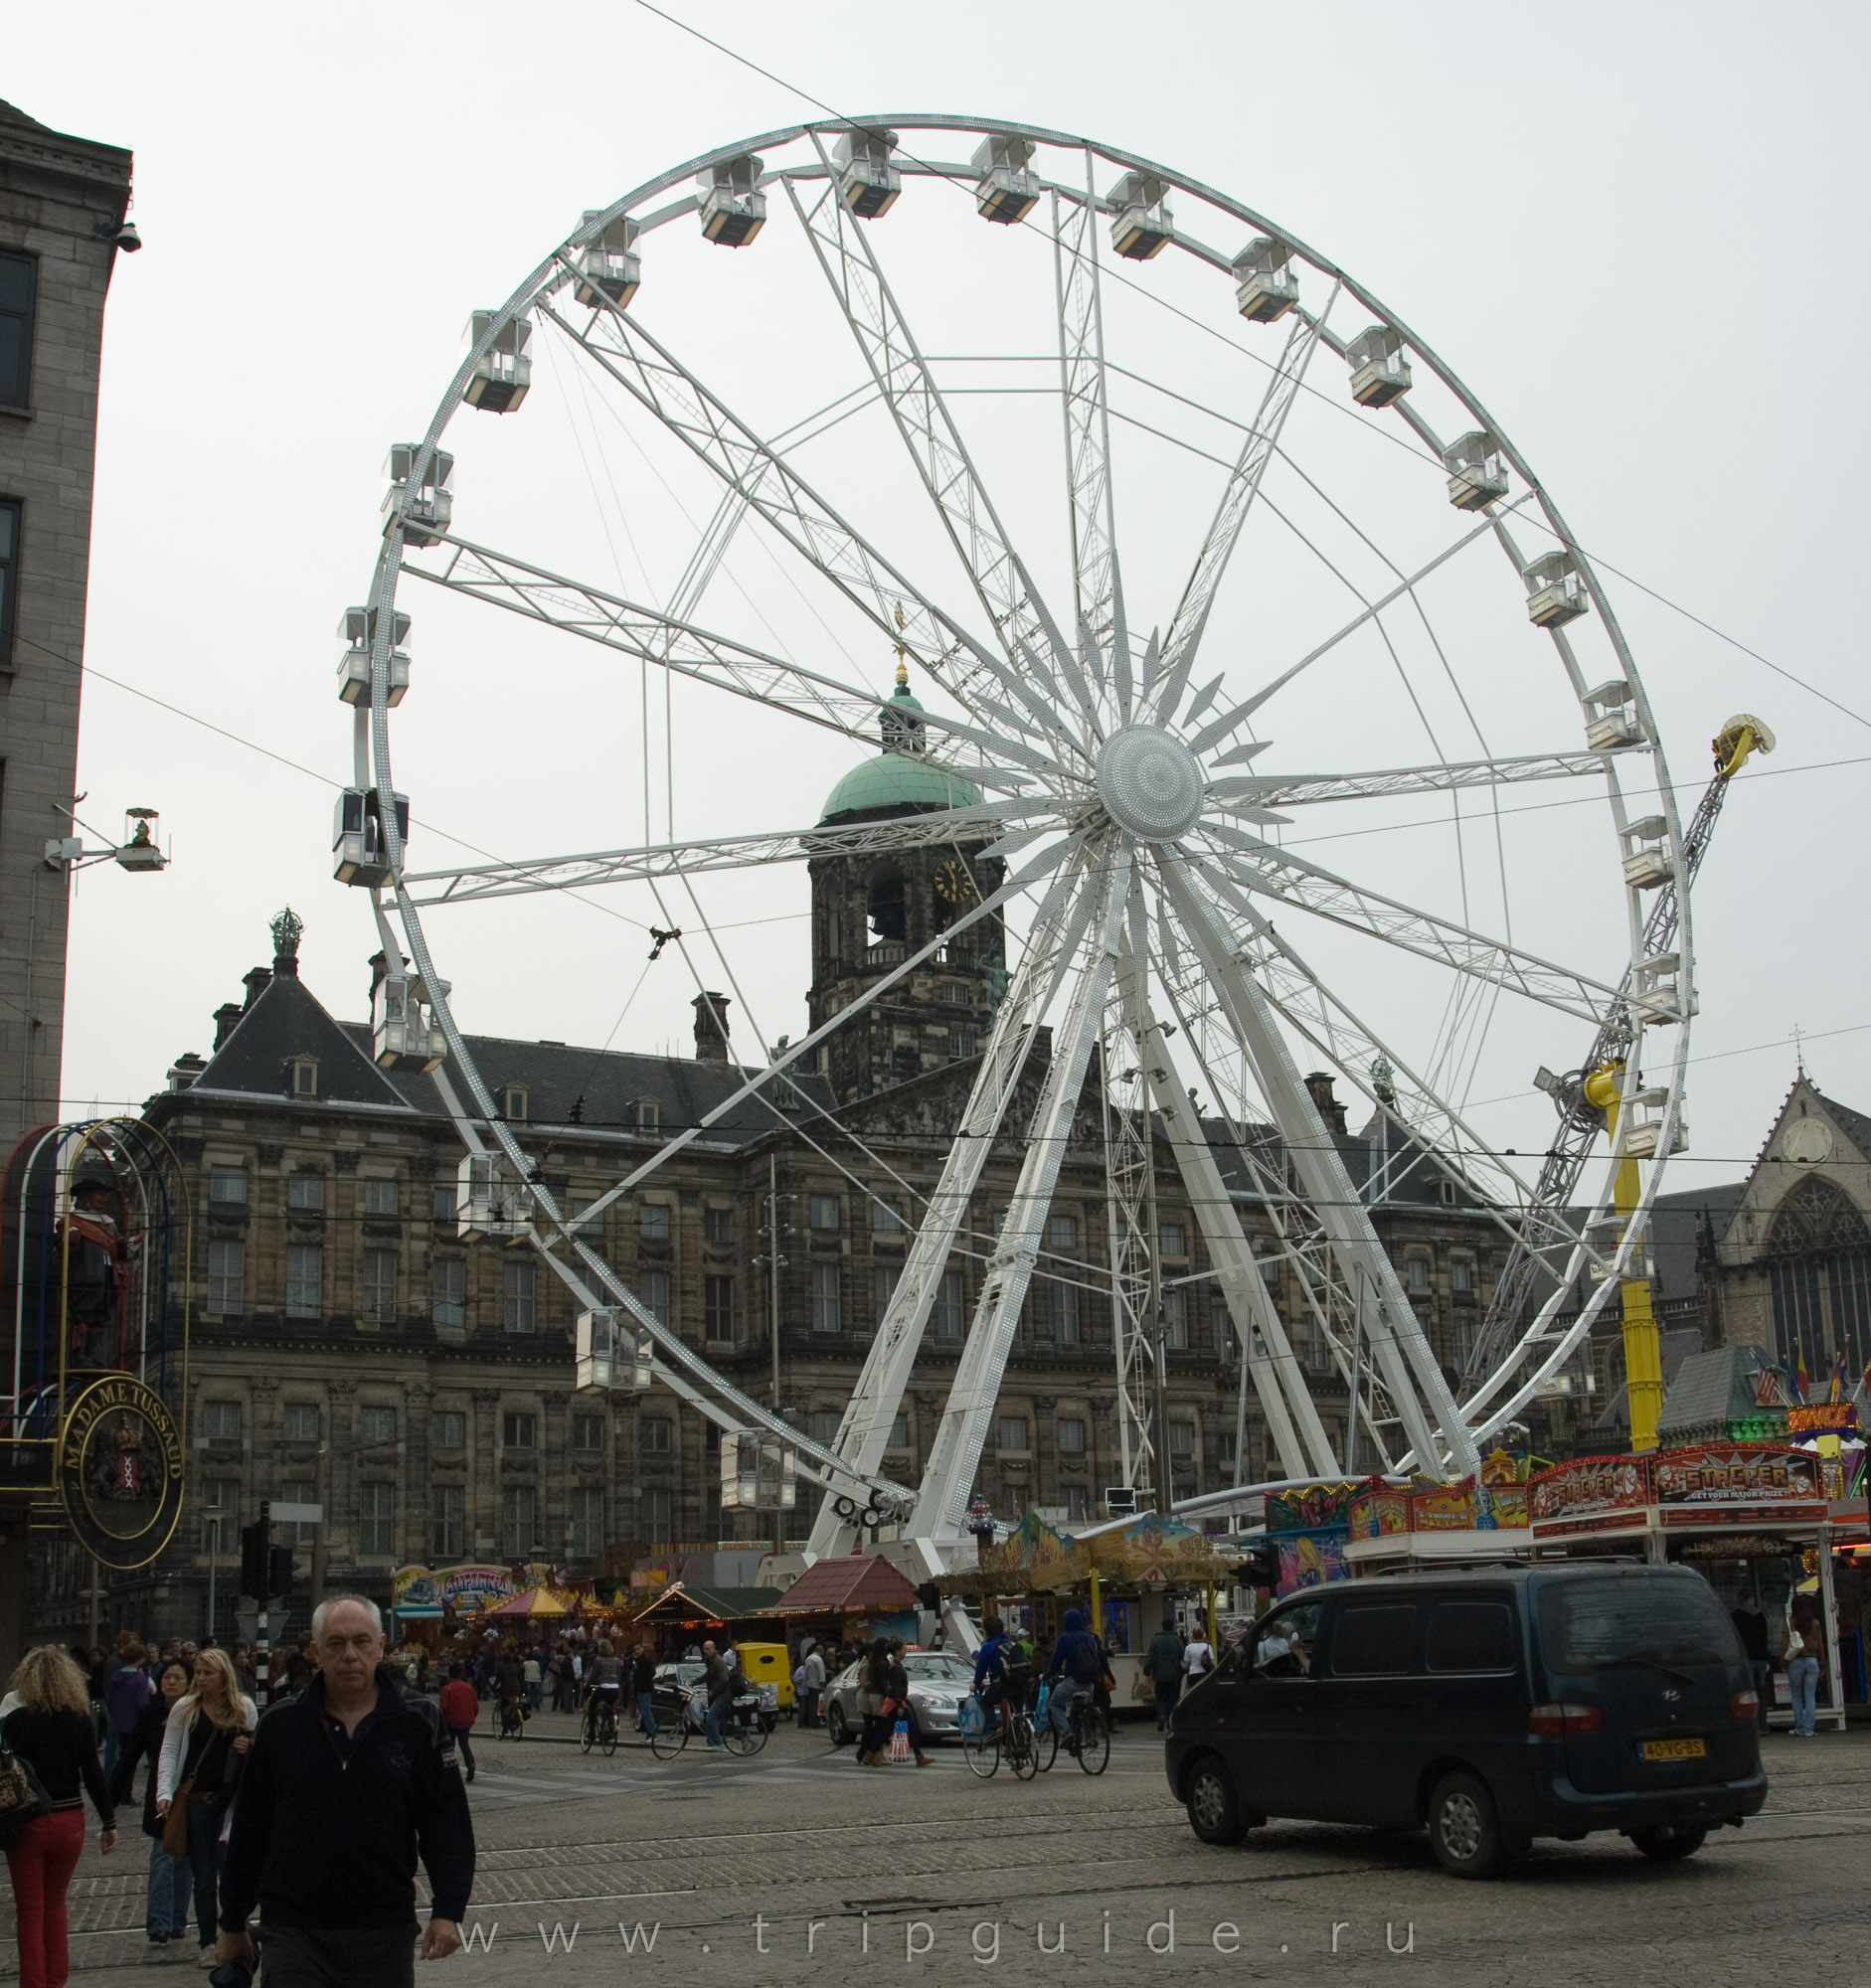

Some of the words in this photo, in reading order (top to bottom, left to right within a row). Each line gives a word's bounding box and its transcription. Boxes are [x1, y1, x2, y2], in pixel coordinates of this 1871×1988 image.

[66, 1383, 129, 1470] MADAME
[131, 1385, 182, 1480] TUSSAUD
[1558, 1476, 1614, 1505] STACKER
[1685, 1464, 1789, 1490] STACKER
[1646, 1740, 1702, 1757] 40-VG-BS
